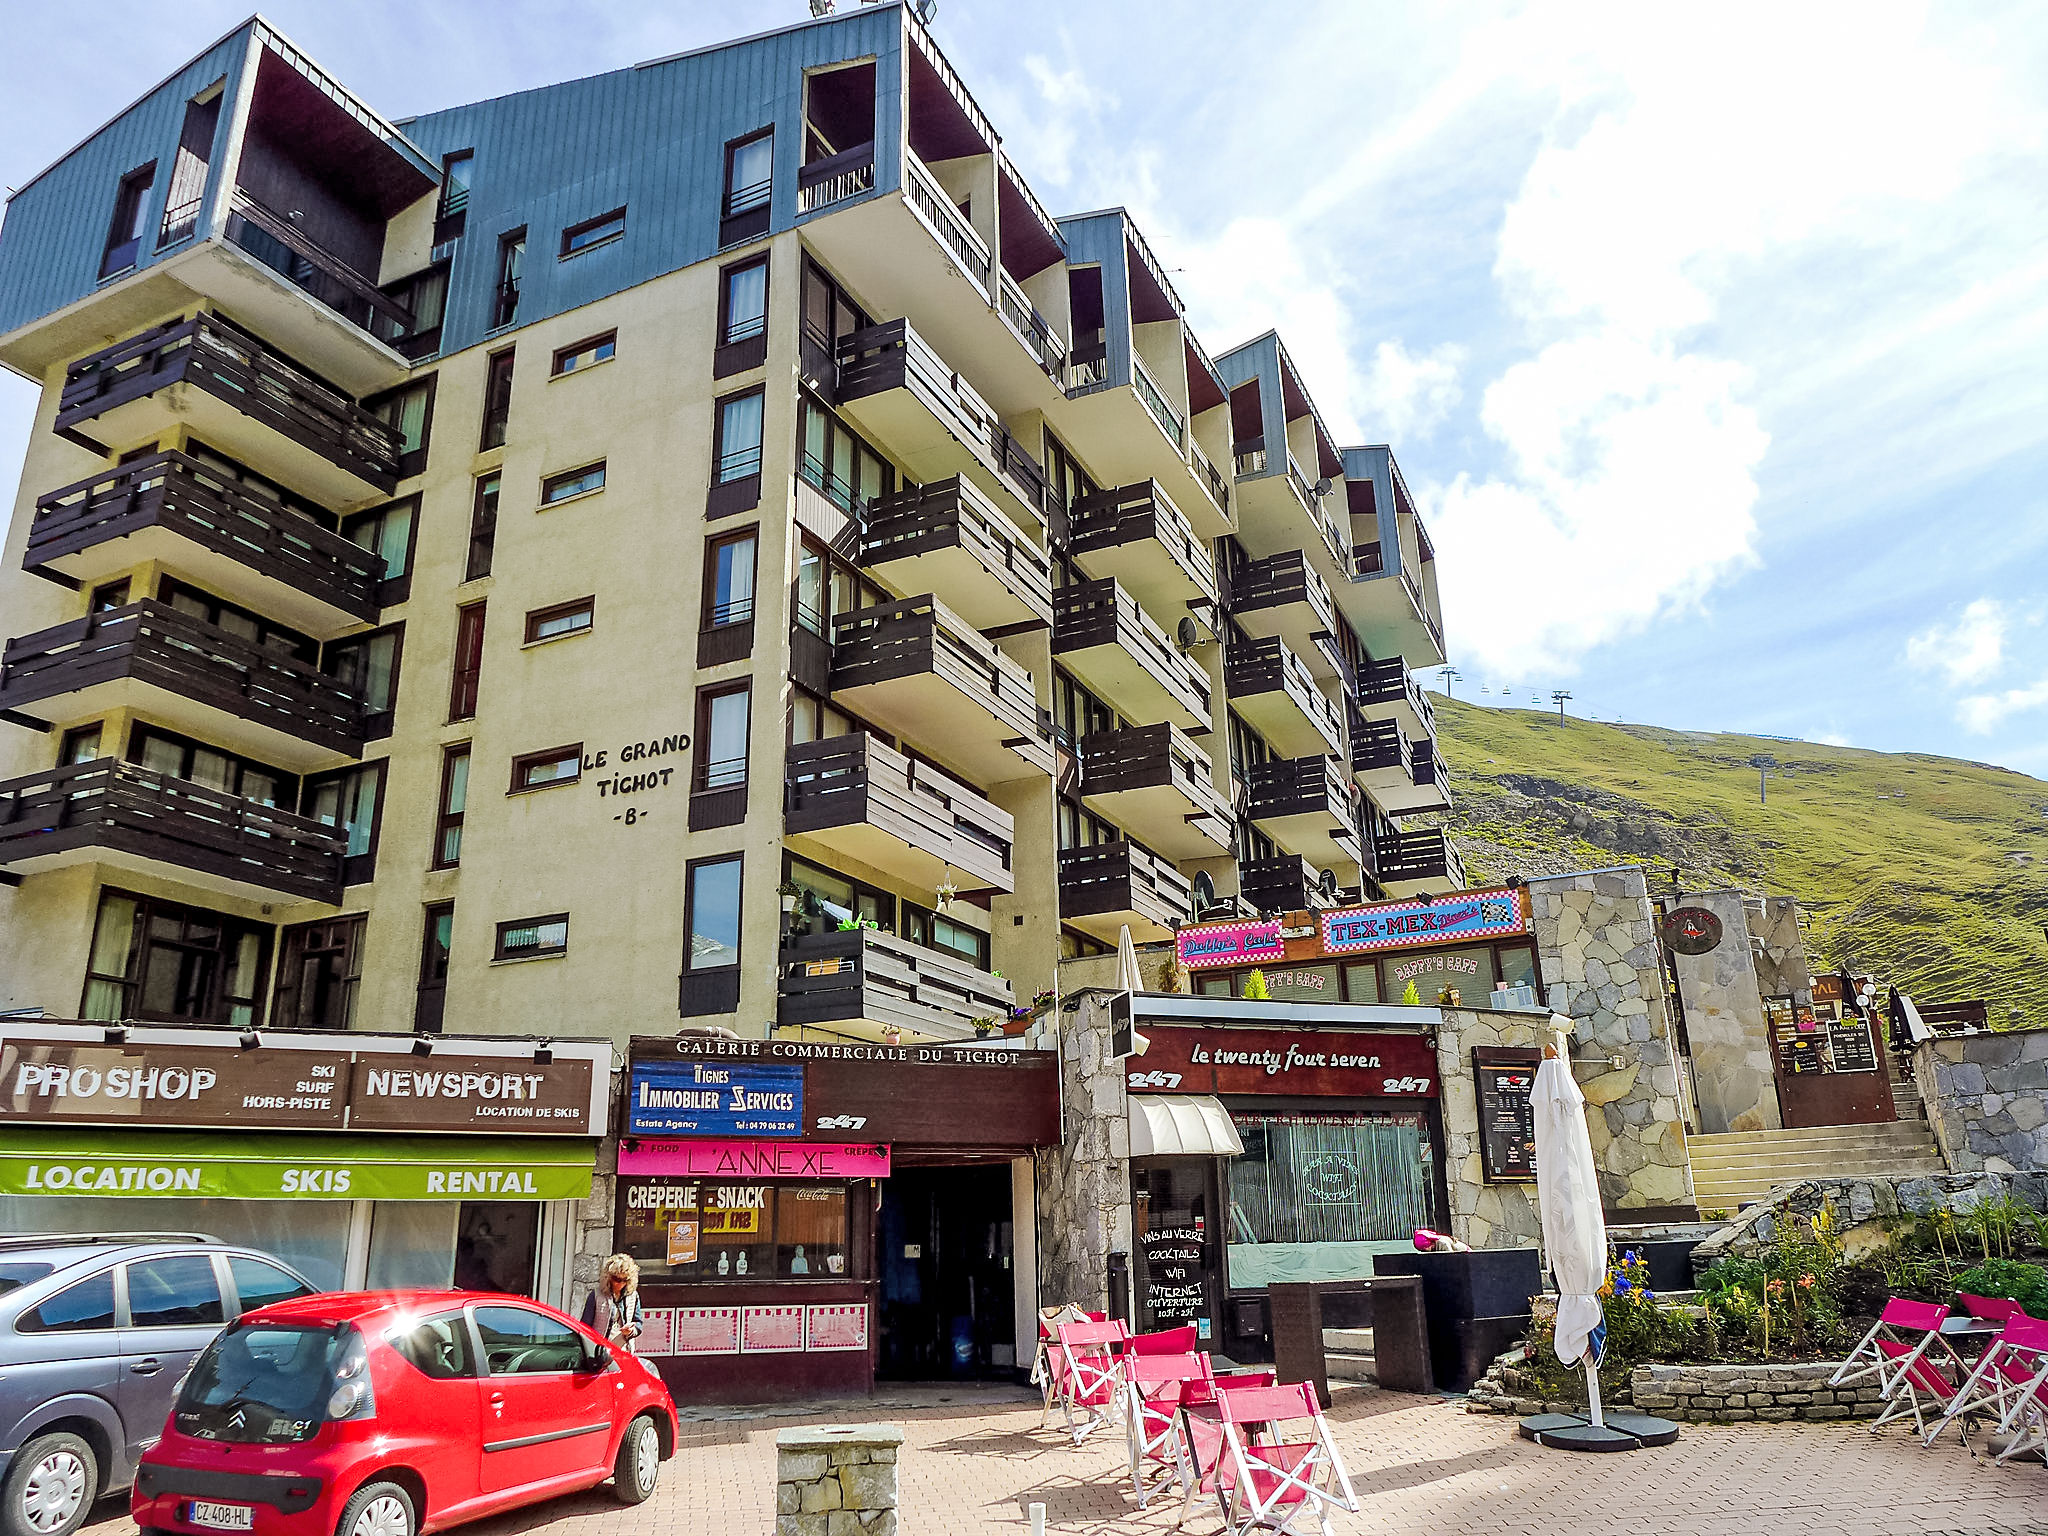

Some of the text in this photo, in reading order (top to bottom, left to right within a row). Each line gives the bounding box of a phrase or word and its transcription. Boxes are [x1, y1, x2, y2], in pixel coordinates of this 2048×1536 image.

[583, 734, 691, 770] LE GRAND
[1332, 913, 1438, 941] TEX-MEX
[1394, 956, 1478, 982] DAFFY'S CAFE
[676, 1041, 1020, 1065] GALERIE COMMERCIALE DU TICHOT
[1191, 1044, 1381, 1074] le twenty four seven
[311, 1065, 336, 1078] SKI
[694, 1064, 729, 1084] TIGNES
[1128, 1070, 1182, 1089] 247
[296, 1080, 334, 1094] SURF
[366, 1069, 544, 1100] NEWSPORT
[1382, 1076, 1431, 1094] 247
[242, 1096, 332, 1110] HORS-PISTE
[639, 1082, 793, 1112] IMMOBILIER SERVICES
[476, 1105, 580, 1119] LOCATION DE SKIS
[636, 1119, 698, 1130] Estate Agency
[750, 1122, 758, 1130] 04
[759, 1122, 767, 1130] 79
[777, 1122, 786, 1130] 32
[786, 1122, 795, 1130] 49
[816, 1114, 867, 1130] 247
[651, 1144, 680, 1153] FOOD
[688, 1144, 841, 1175] L'ANNEXE
[26, 1166, 539, 1194] LOCATION SKIS RENTAL
[717, 1185, 766, 1208] SNACK
[1306, 1181, 1358, 1201] COCKTAILS
[1140, 1228, 1205, 1244] VINS AU VERRE
[1148, 1248, 1200, 1261] COCKTAILS
[1165, 1267, 1186, 1280] WIFI
[1148, 1282, 1202, 1298] INTERNET
[1147, 1298, 1204, 1308] OUVERTURE
[1158, 1308, 1175, 1318] 10H
[1180, 1307, 1194, 1317] 2H
[293, 1419, 313, 1430] C1
